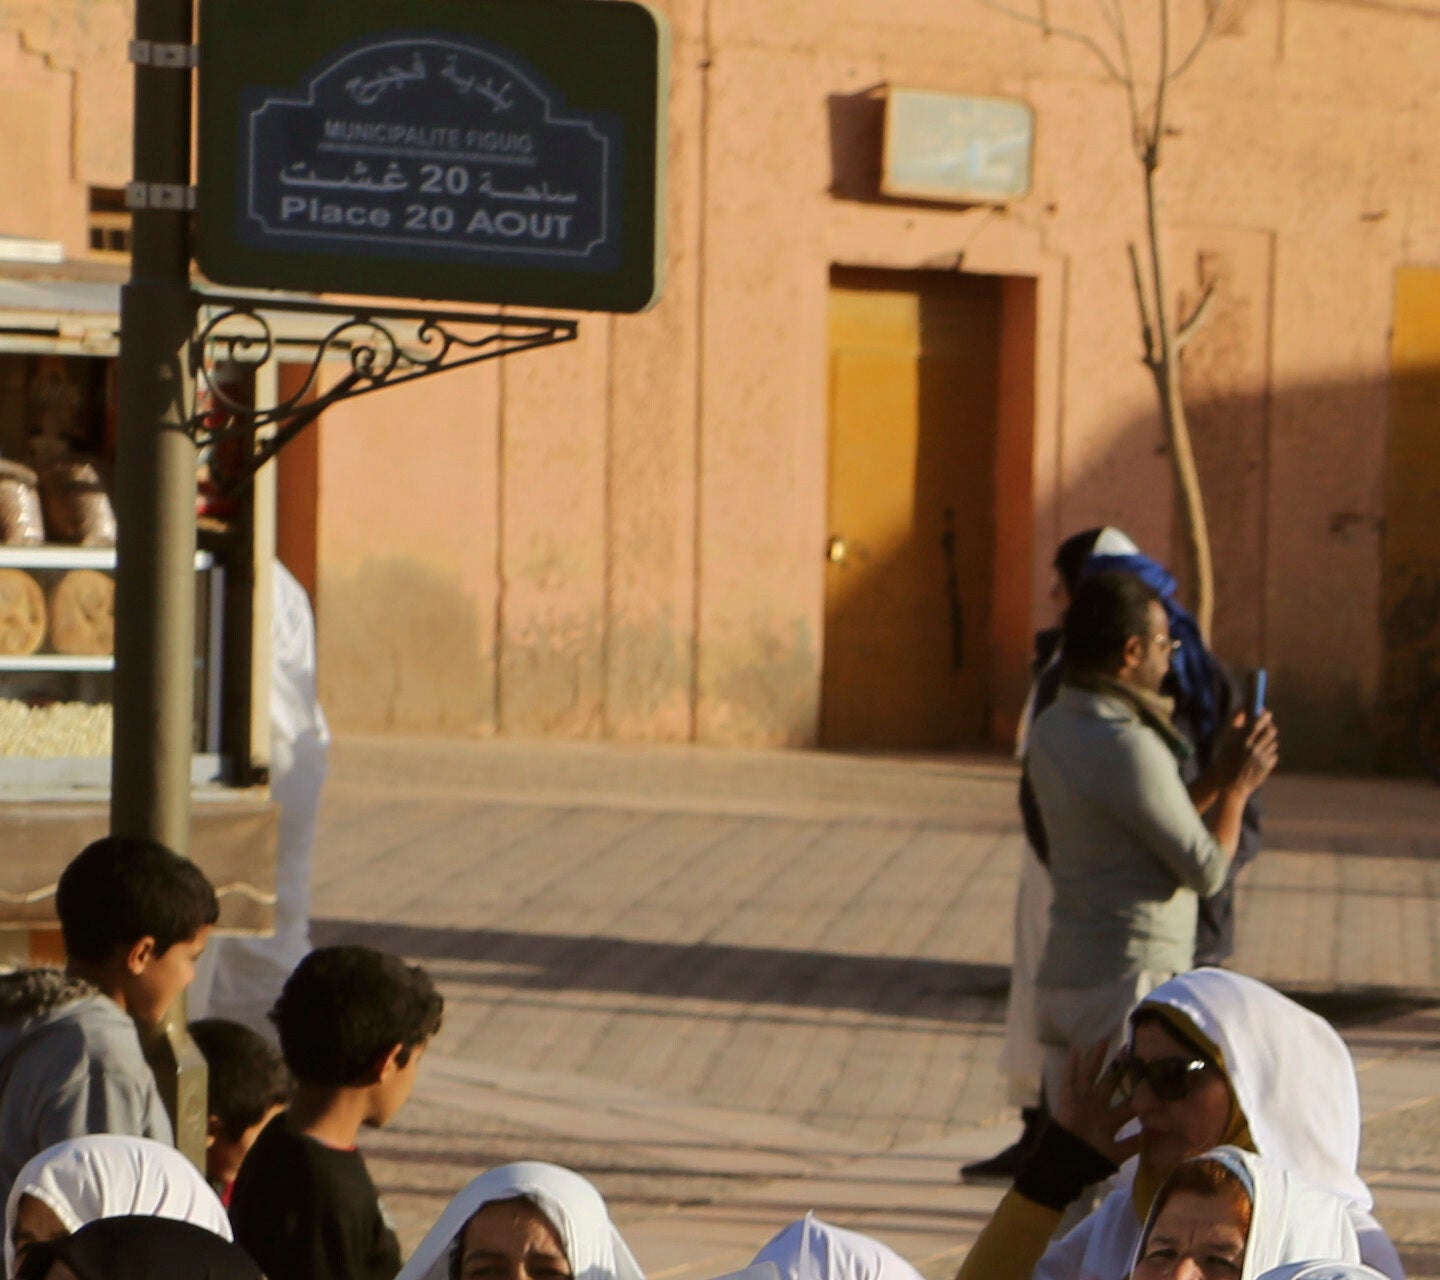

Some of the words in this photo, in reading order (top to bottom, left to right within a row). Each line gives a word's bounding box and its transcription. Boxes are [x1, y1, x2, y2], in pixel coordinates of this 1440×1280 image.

[441, 54, 515, 113] بلدية
[324, 119, 460, 147] MUNICIPALITE
[466, 129, 533, 153] FIGUIG
[279, 161, 409, 192] غشت
[419, 163, 470, 195] 20
[478, 172, 577, 203] ساحة
[280, 196, 392, 228] Place
[404, 204, 455, 232] 20
[465, 209, 574, 240] AOUT
